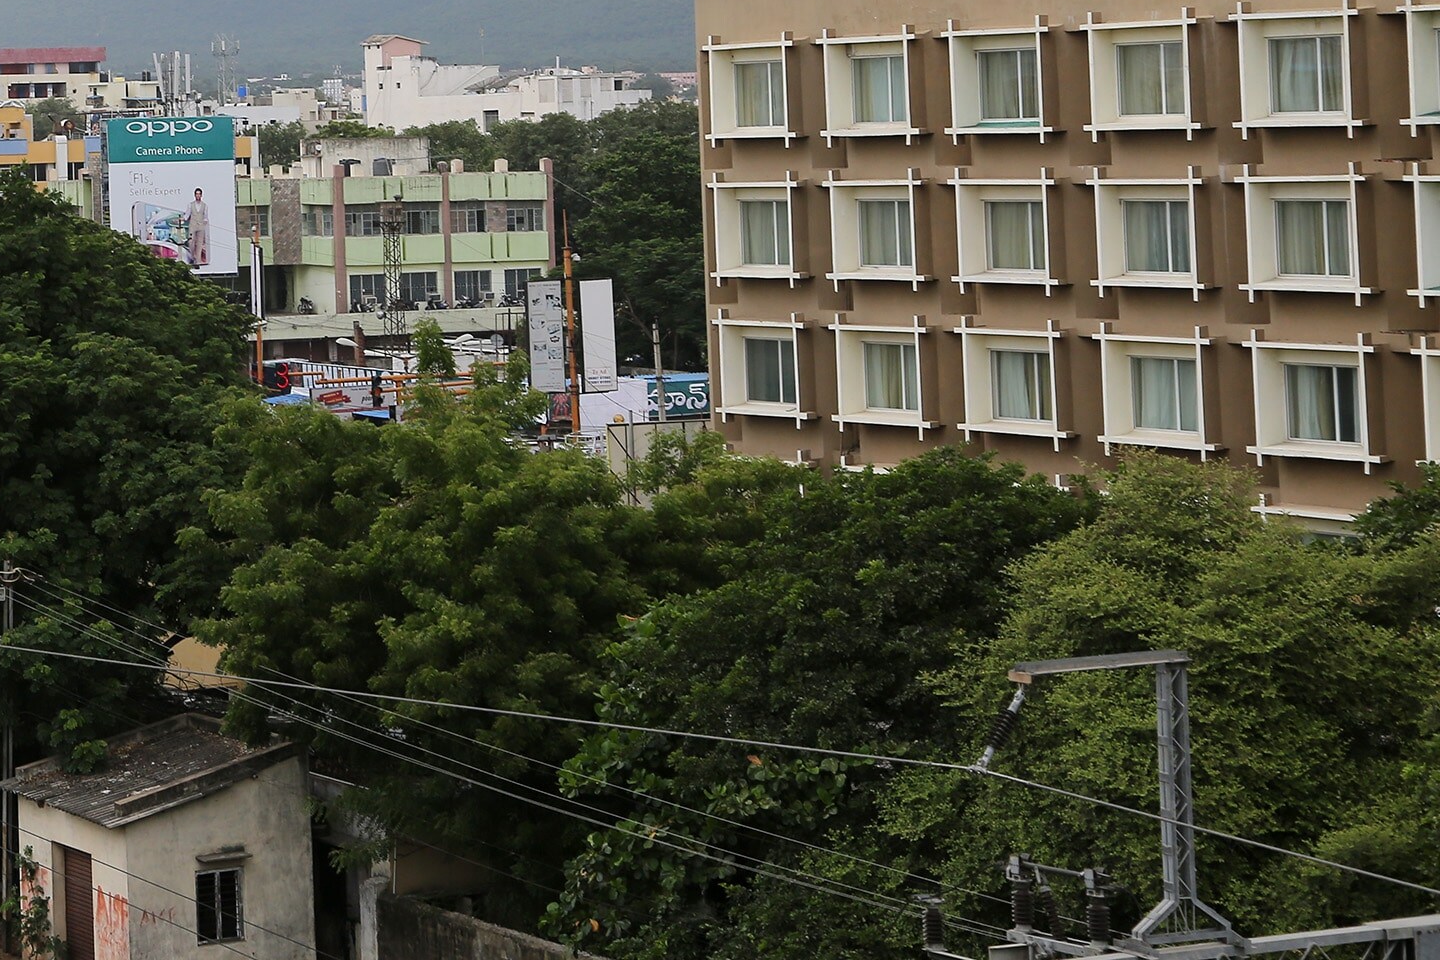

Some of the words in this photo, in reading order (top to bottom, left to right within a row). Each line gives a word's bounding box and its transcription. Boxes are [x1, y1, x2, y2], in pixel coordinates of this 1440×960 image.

[135, 146, 172, 156] Camera
[175, 145, 203, 155] Phone
[133, 173, 149, 184] F1s
[130, 188, 153, 197] Selfie
[155, 187, 181, 197] Expert
[276, 363, 289, 389] 3
